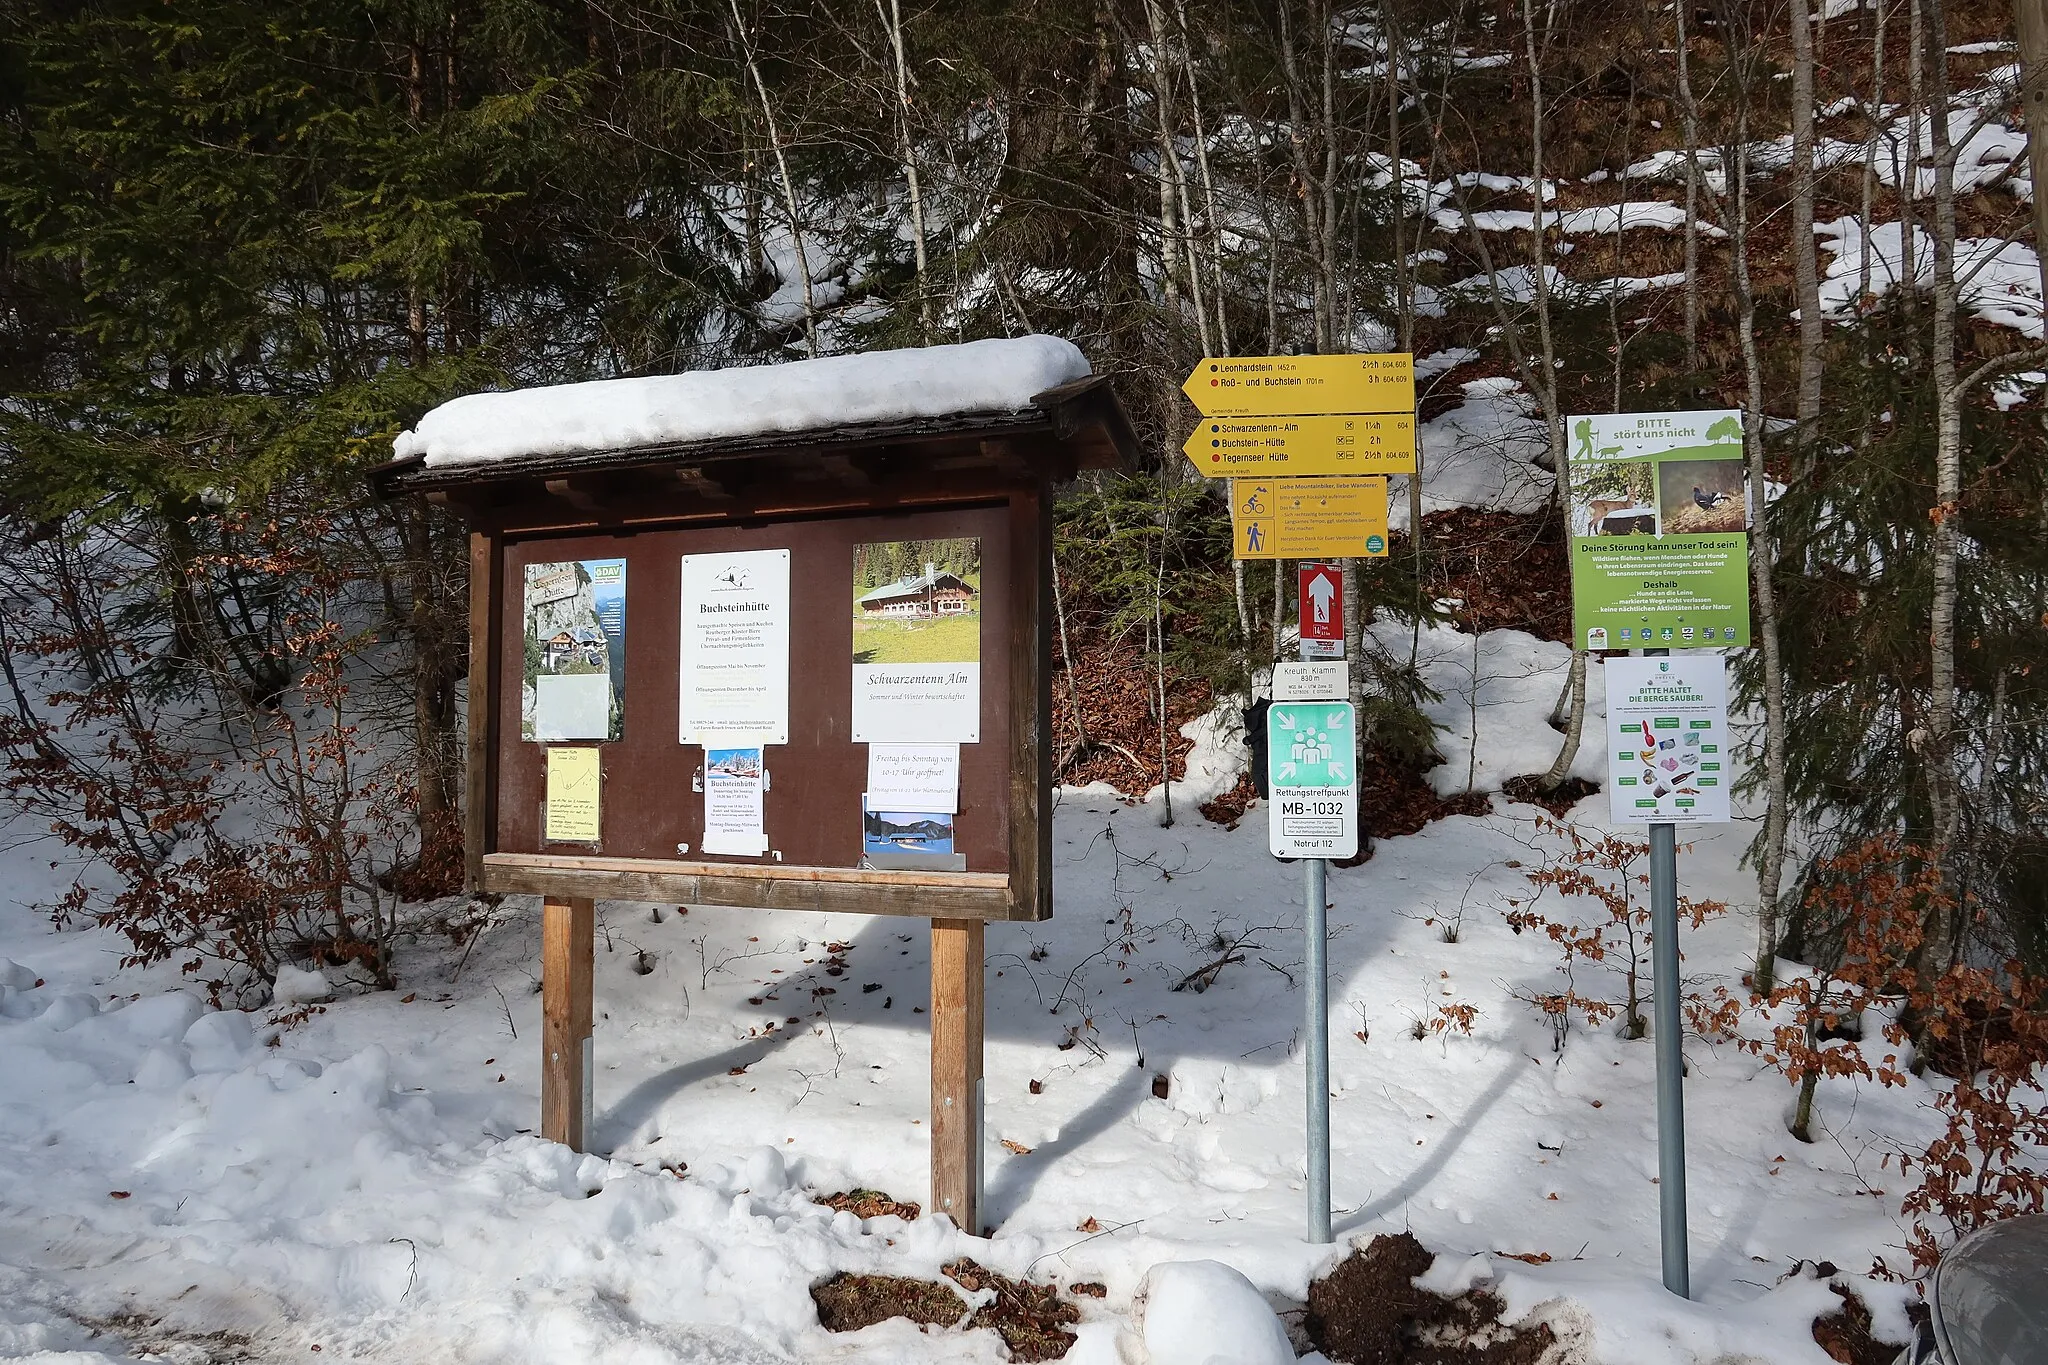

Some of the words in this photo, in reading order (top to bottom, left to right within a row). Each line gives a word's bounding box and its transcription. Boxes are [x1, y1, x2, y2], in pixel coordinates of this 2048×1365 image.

[1220, 363, 1273, 372] Leonhardstein
[1245, 378, 1260, 386] und
[1264, 377, 1302, 385] Buchstein
[1368, 375, 1373, 383] 3
[1374, 375, 1379, 383] h
[1637, 419, 1671, 428] BITTE
[1613, 430, 1641, 439] stört
[1666, 428, 1696, 437] nicht
[1370, 436, 1375, 444] 2
[1376, 436, 1381, 444] h
[1223, 454, 1264, 463] Tegernseer
[1269, 453, 1289, 461] Hütte
[1609, 543, 1645, 552] Störung
[1647, 542, 1669, 550] kann
[1671, 542, 1696, 550] unser
[1716, 541, 1738, 549] sein!
[602, 568, 620, 576] DAV
[699, 602, 770, 613] Buchsteinhütte
[867, 673, 944, 685] Schwarzentenn
[944, 672, 968, 685] Alm
[875, 755, 900, 765] Freitag
[901, 754, 911, 762] bis
[912, 755, 939, 765] Sonntag
[1276, 789, 1350, 798] Rettungstreffpunkt
[1282, 803, 1343, 814] MB-1032
